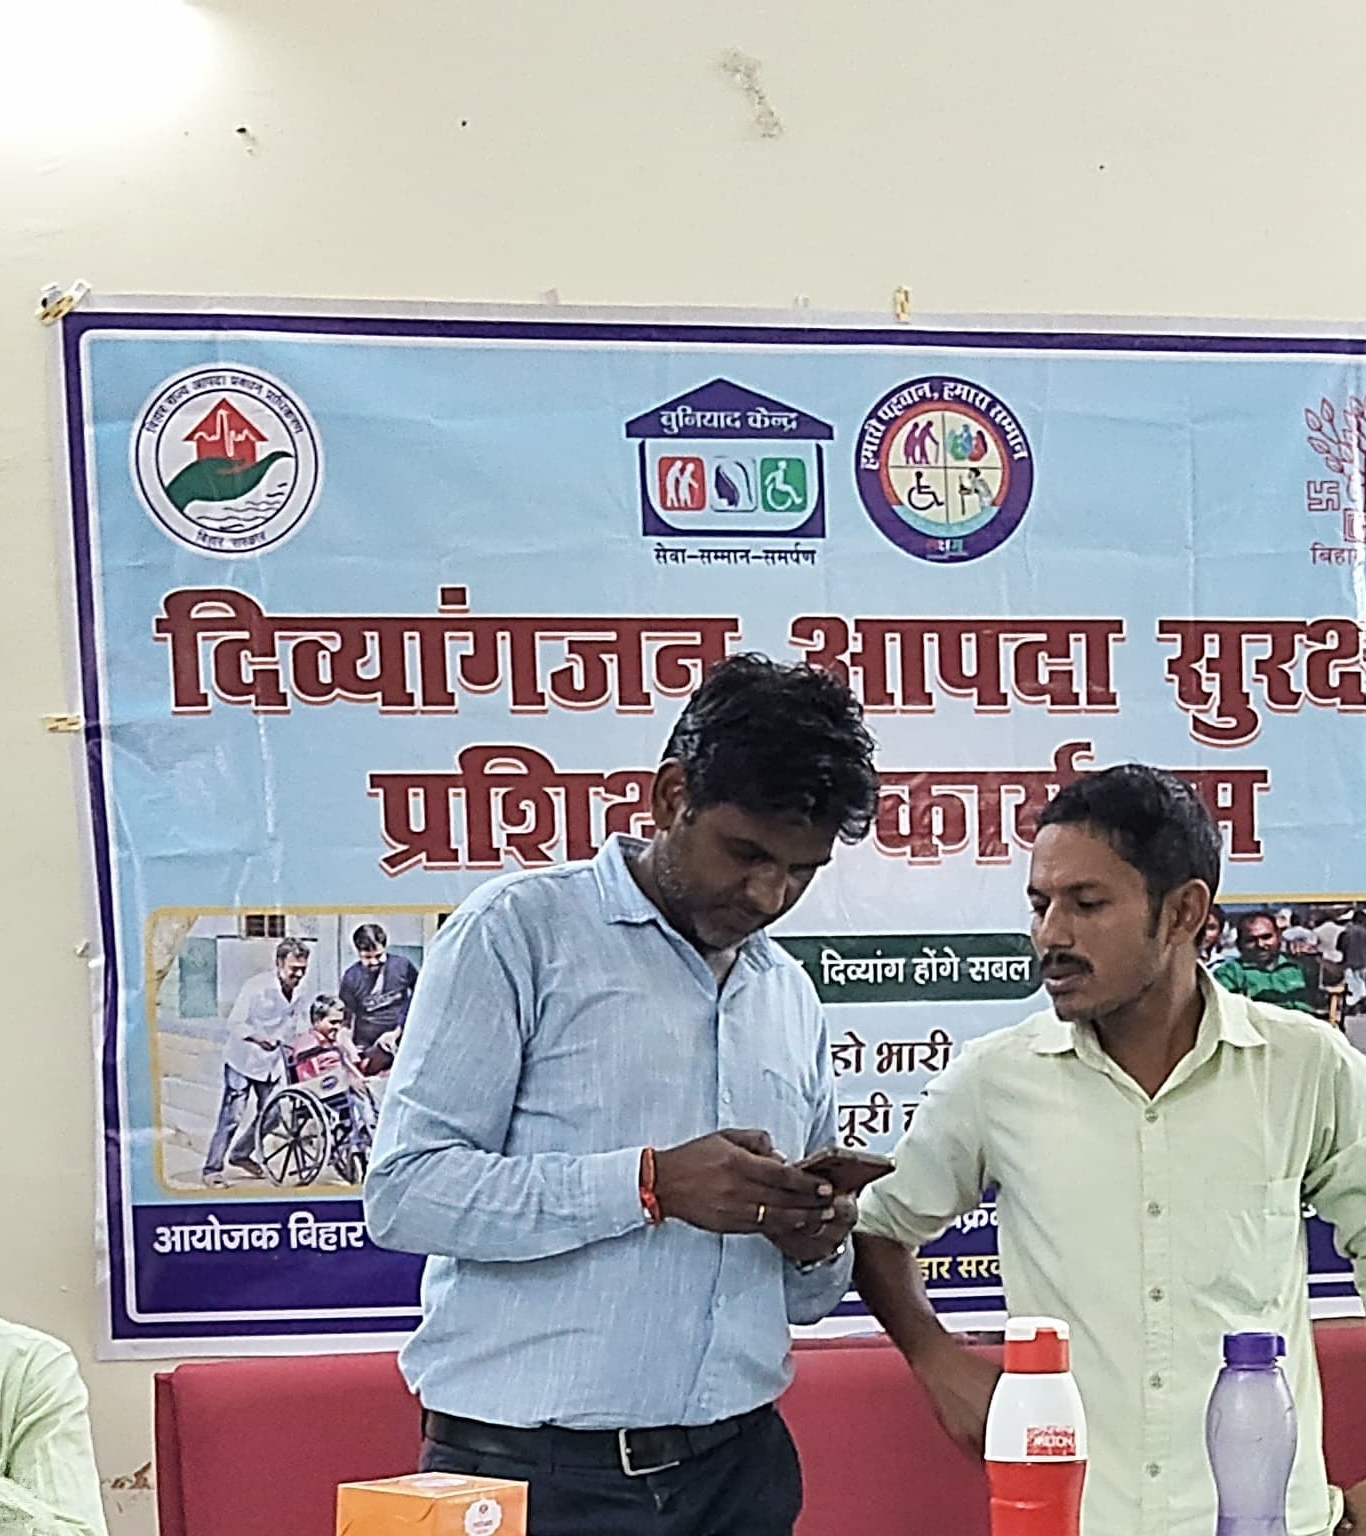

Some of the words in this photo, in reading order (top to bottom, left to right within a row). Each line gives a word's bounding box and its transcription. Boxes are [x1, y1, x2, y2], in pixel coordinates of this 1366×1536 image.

[660, 405, 741, 435] बुनियाद
[747, 407, 799, 433] केन्द्र
[1309, 541, 1366, 567] बिहा
[153, 585, 741, 716] दिव्यांगजन
[788, 615, 1127, 715] आपदा
[821, 948, 906, 986] दिव्यांग
[912, 946, 961, 984] होंगे
[967, 955, 1033, 982] सबल
[876, 1028, 954, 1074] भारी
[153, 1214, 282, 1253] आयोजक
[288, 1211, 367, 1251] बिहार
